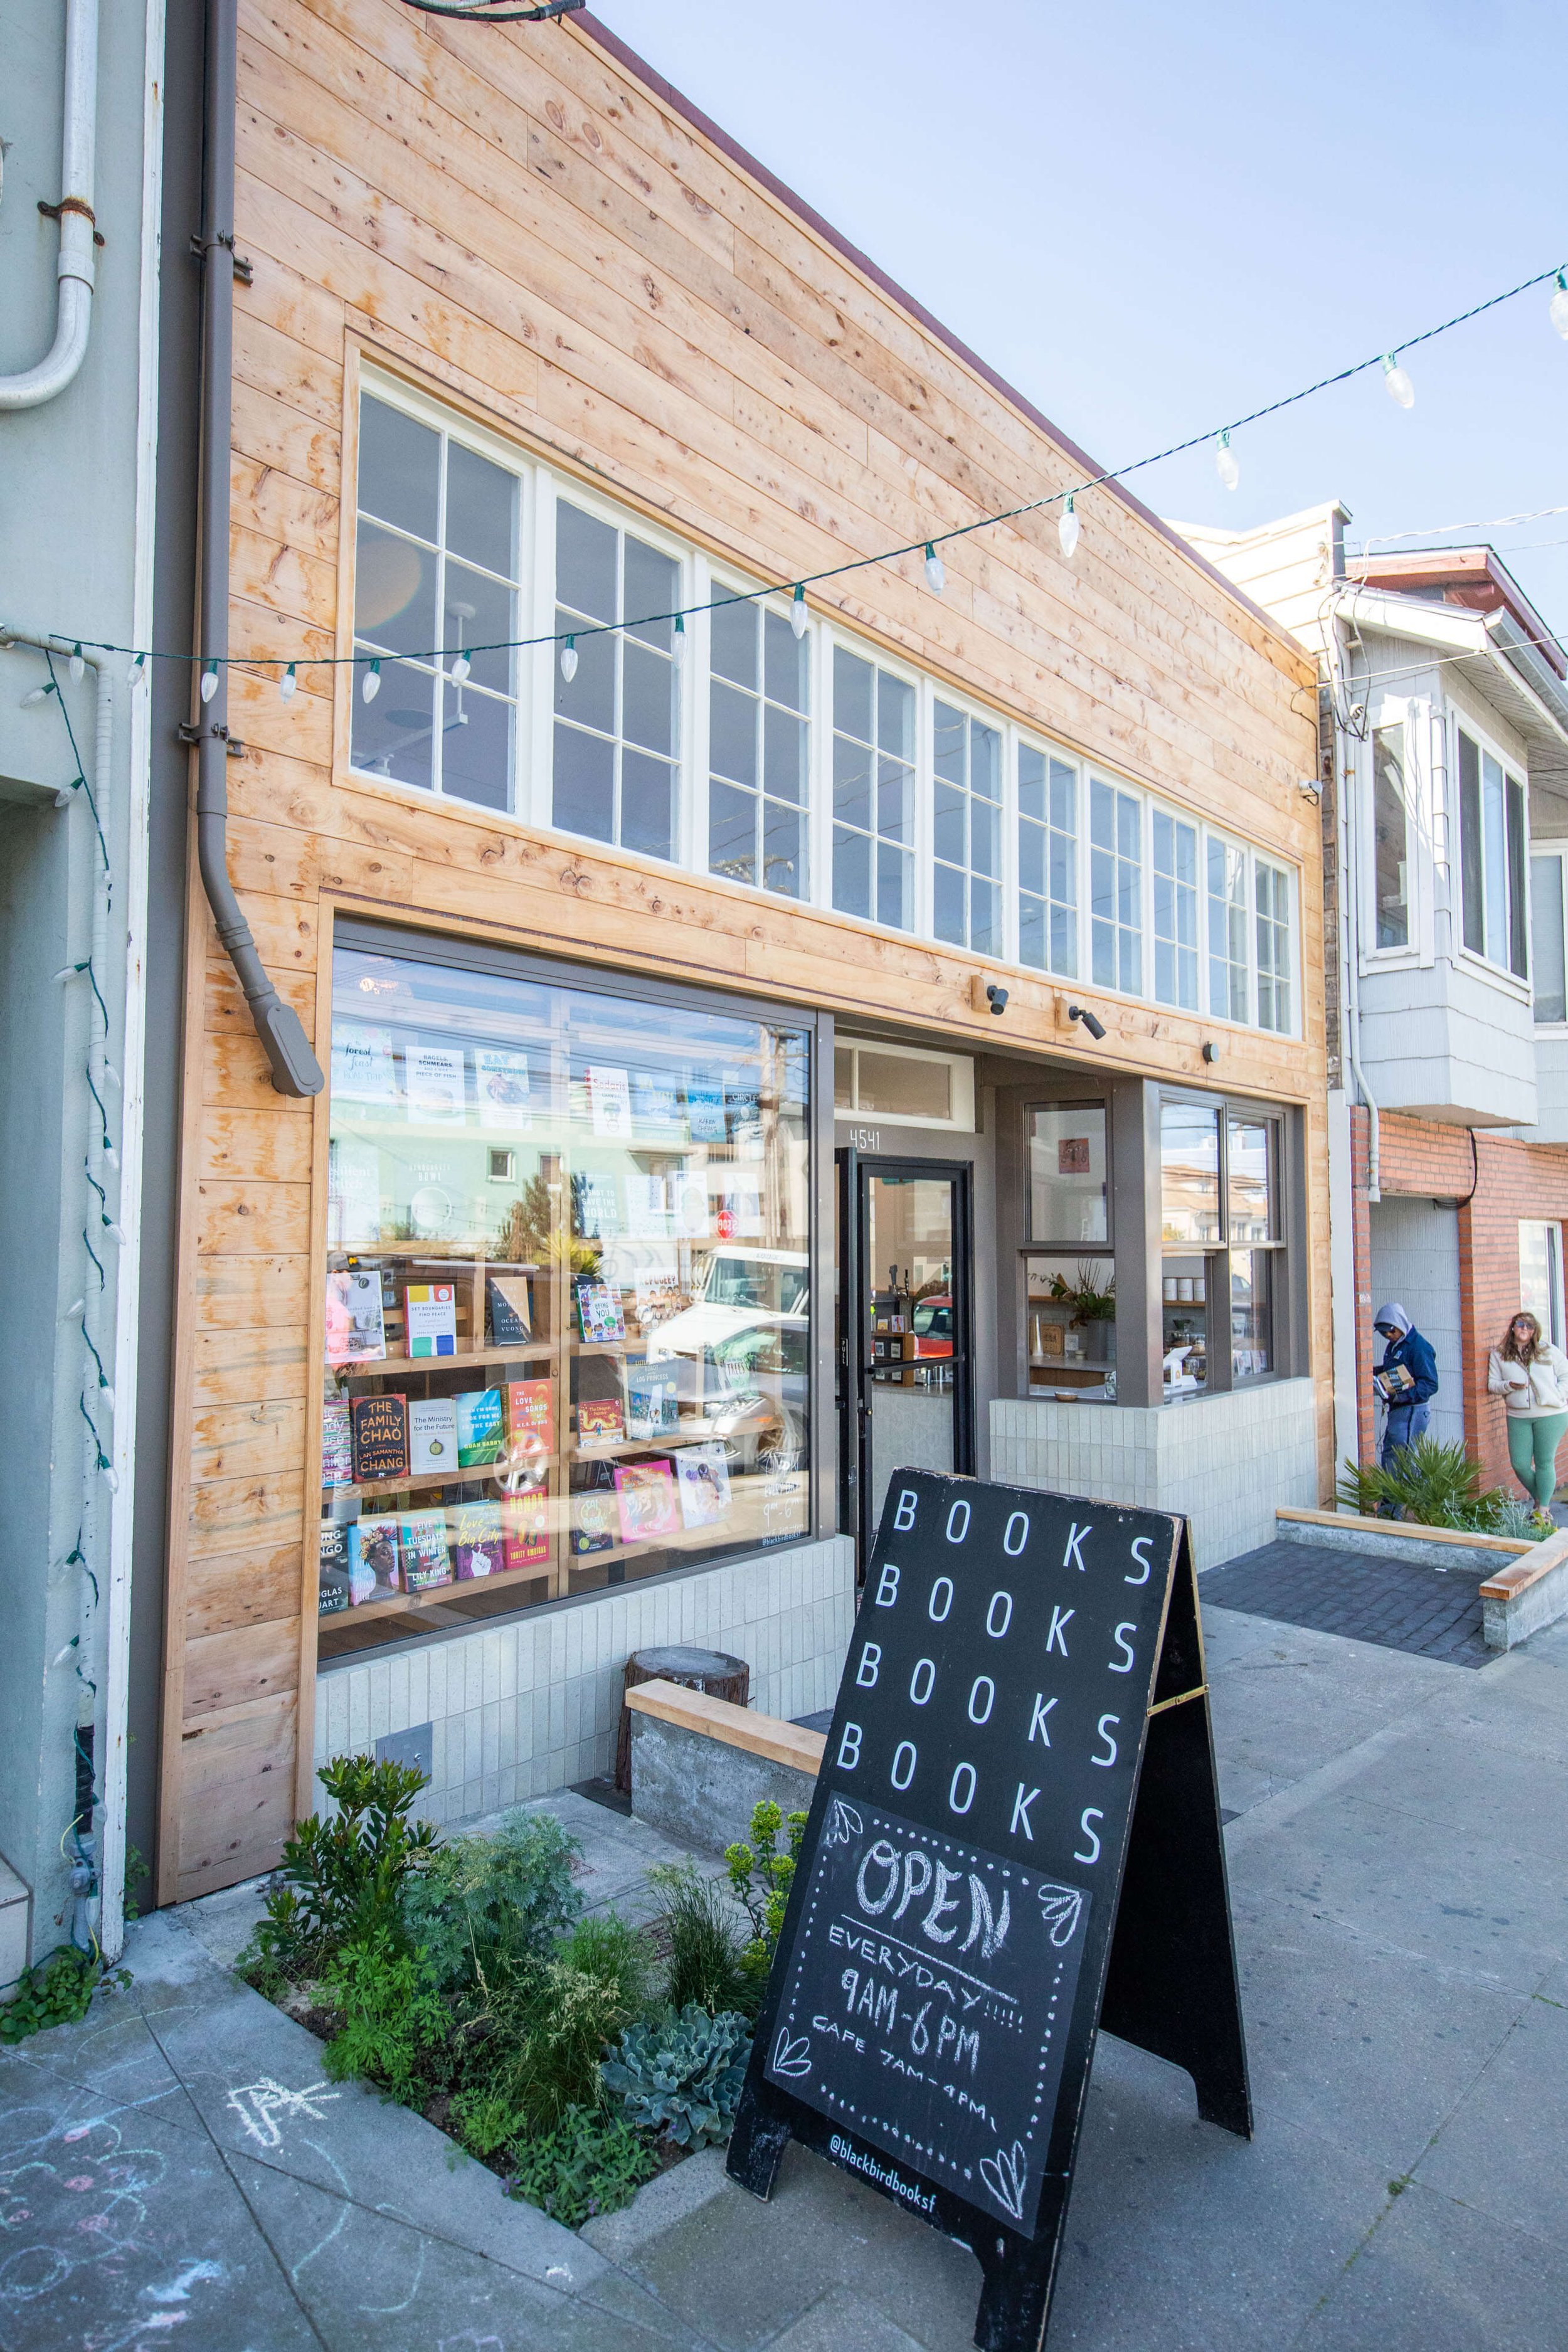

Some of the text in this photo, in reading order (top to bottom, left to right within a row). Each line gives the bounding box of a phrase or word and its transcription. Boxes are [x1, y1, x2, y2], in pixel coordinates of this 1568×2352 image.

[345, 1042, 371, 1056] forest
[349, 1056, 373, 1071] feast
[483, 1054, 509, 1064] EAT
[594, 1078, 626, 1091] Sedaris
[732, 1093, 758, 1102] CIRCLE
[850, 1129, 879, 1150] 4541
[418, 1172, 442, 1182] BOWL
[583, 1207, 617, 1218] WORLD
[596, 1310, 610, 1318] YOU
[647, 1373, 669, 1382] PRINCESS
[368, 1401, 392, 1414] THE
[516, 1397, 532, 1405] LOVE
[525, 1404, 548, 1412] SONGS
[361, 1415, 401, 1430] FAMILY
[361, 1428, 401, 1444] CHAO
[361, 1457, 403, 1471] CHANG
[510, 1493, 543, 1513] HONOR
[417, 1520, 432, 1529] FIVE
[460, 1514, 484, 1530] Love
[407, 1532, 444, 1546] TUESDAYS
[458, 1527, 499, 1547] Big City
[893, 1490, 1153, 1585] BOOKS
[408, 1546, 446, 1559] IN WINTER
[511, 1550, 525, 1560] THRITY
[527, 1545, 546, 1556] UMRIGAR
[413, 1567, 447, 1581] LILY KING
[319, 1587, 342, 1597] GLAS
[875, 1564, 1137, 1673] BOOKS
[856, 1641, 1120, 1767] BOOKS
[837, 1722, 1104, 1864] BOOKS
[856, 1839, 1010, 1959] OPEN
[812, 2015, 867, 2054] CAFE
[830, 2134, 936, 2213] @blackbirdbooksf
